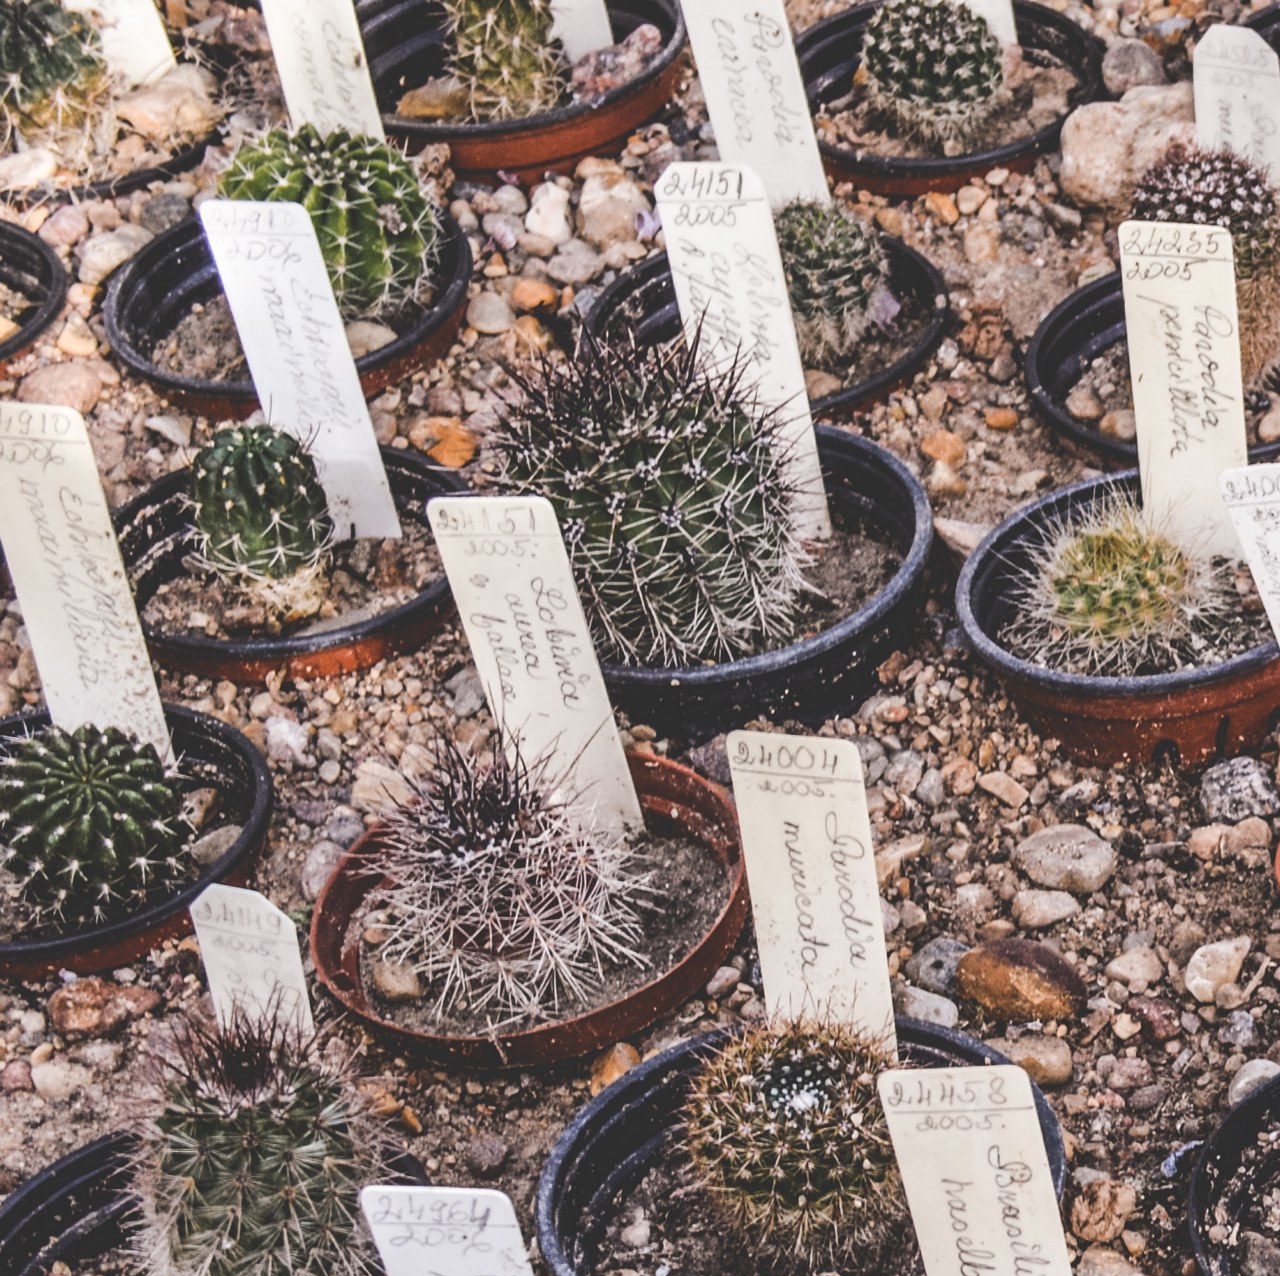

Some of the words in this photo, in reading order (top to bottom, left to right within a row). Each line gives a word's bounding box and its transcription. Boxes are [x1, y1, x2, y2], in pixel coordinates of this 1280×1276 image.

[663, 167, 743, 200] 24151
[675, 202, 748, 228] 2005
[1122, 229, 1223, 256] 24235
[1126, 259, 1209, 281] 2005
[1193, 303, 1235, 430] Parodia
[0, 409, 70, 436] 4910
[436, 506, 536, 534] 24151
[504, 592, 540, 680] aurea
[736, 741, 840, 774] 24004
[824, 811, 876, 968] Parodia
[887, 1076, 1008, 1108] 24458
